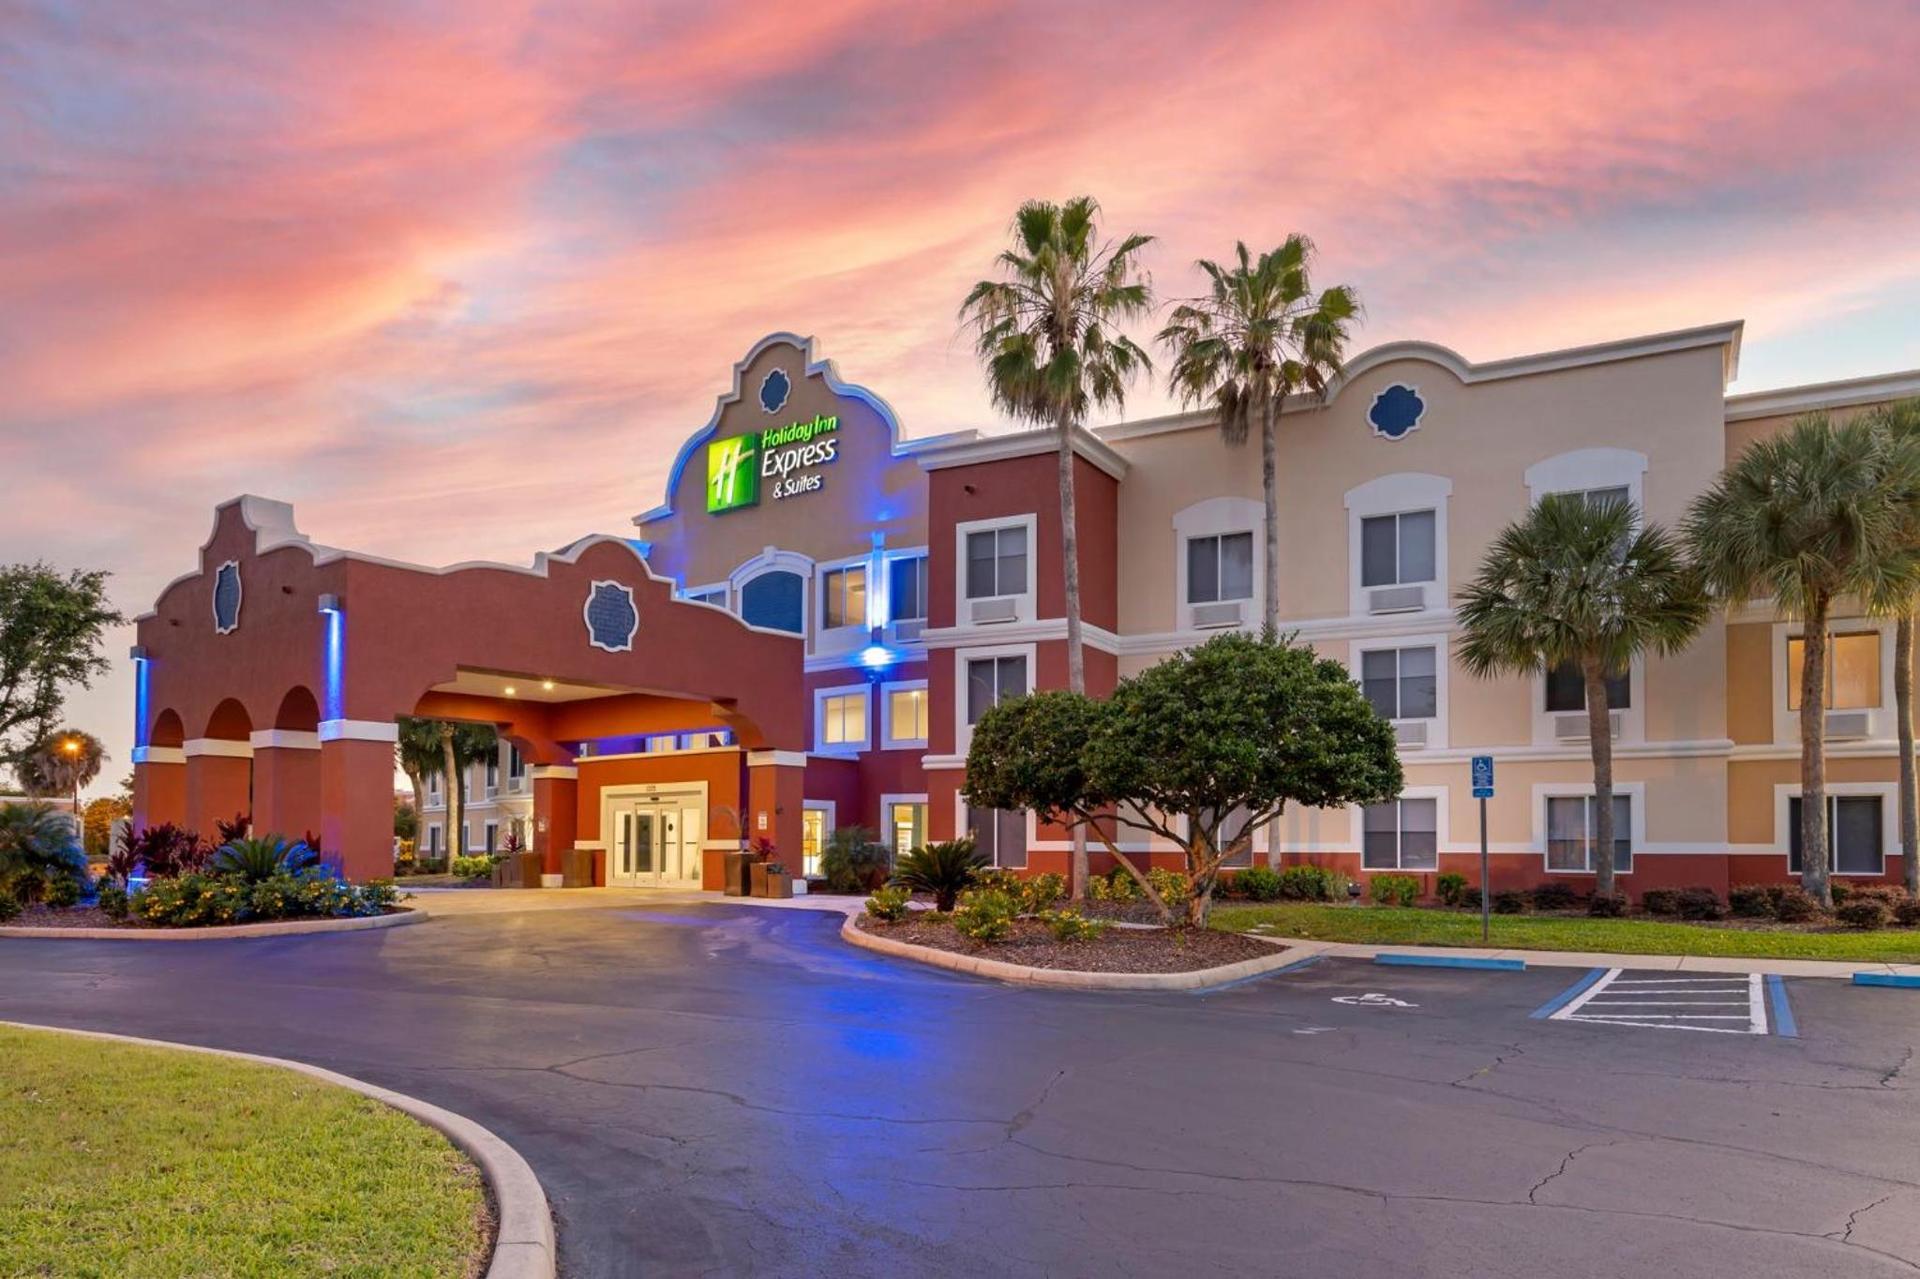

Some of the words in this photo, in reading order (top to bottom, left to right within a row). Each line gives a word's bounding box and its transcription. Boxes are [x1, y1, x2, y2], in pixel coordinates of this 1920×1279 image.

[762, 421, 813, 449] Holiday
[814, 415, 837, 434] Inn
[762, 438, 837, 478] Express
[773, 481, 782, 498] &
[784, 474, 821, 496] Suites
